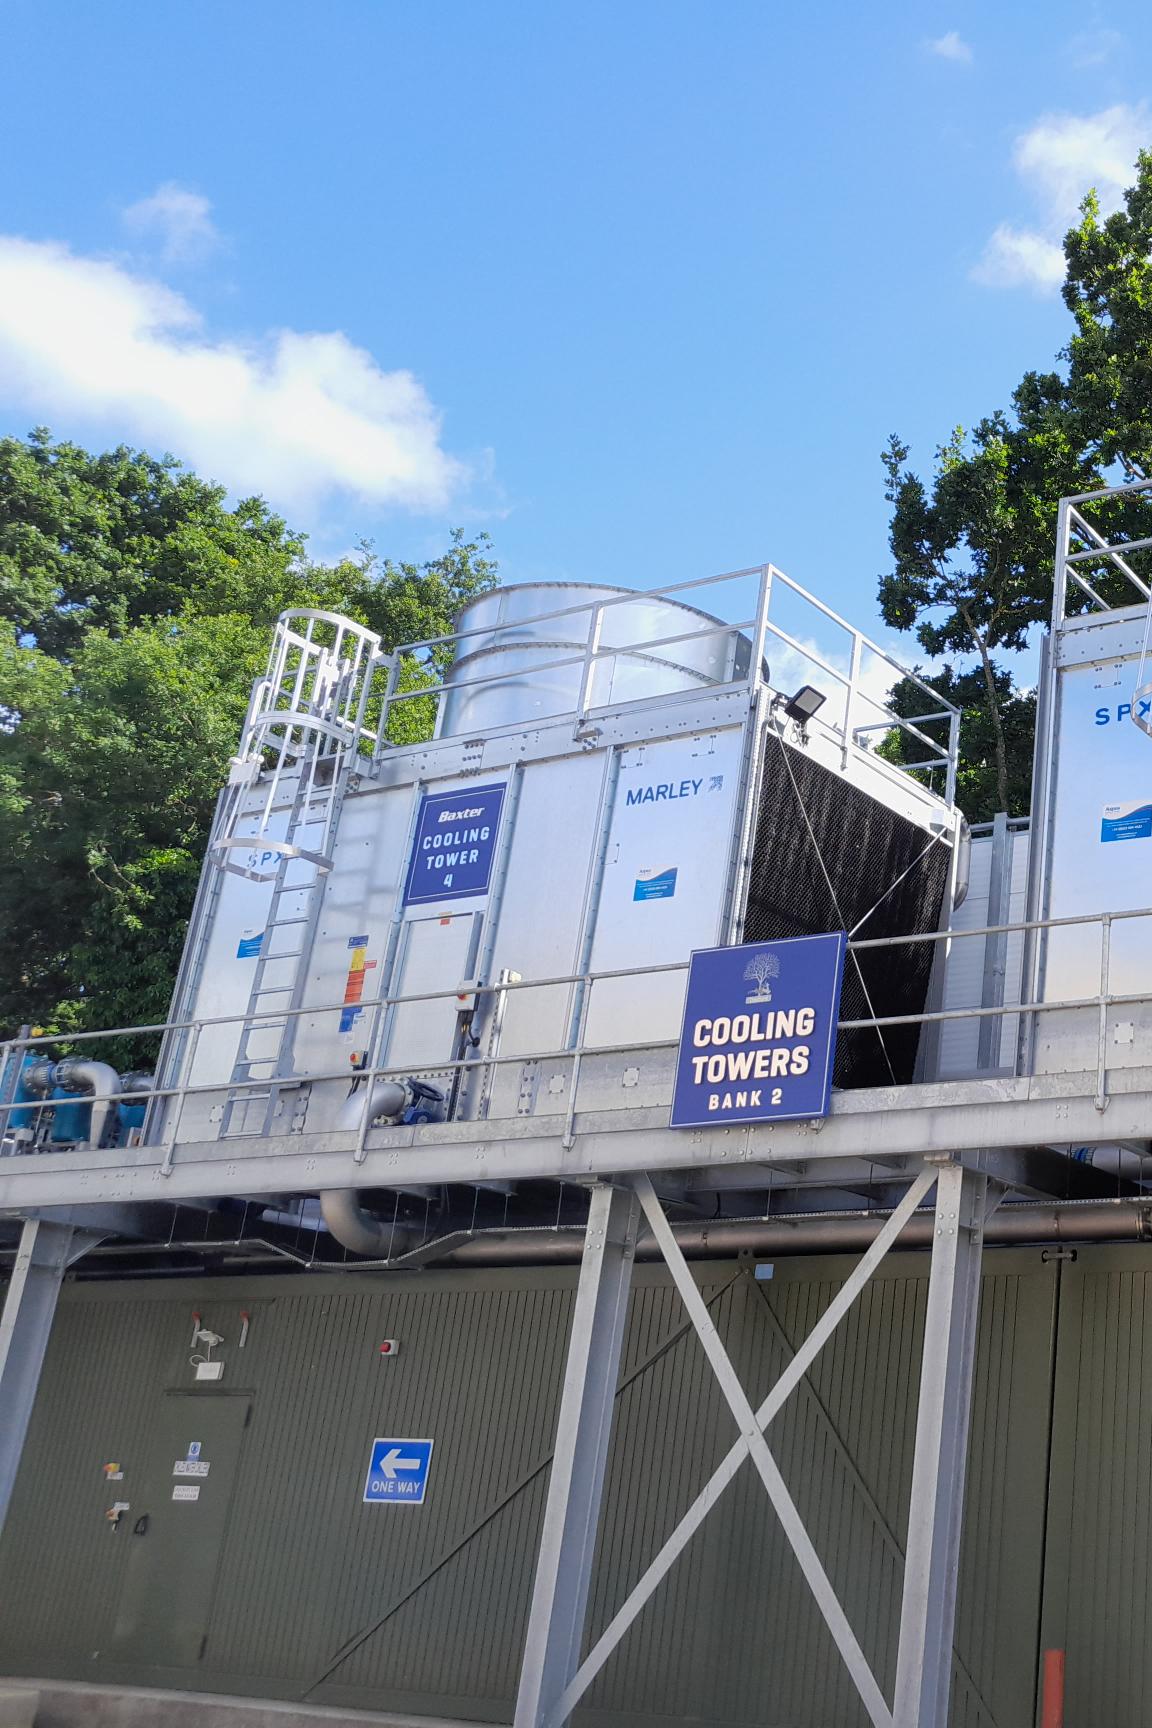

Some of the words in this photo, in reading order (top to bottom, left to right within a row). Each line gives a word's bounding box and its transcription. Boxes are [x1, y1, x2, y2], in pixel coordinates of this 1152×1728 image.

[626, 778, 703, 806] MARLEY
[437, 807, 485, 823] Baxter
[422, 826, 490, 850] COOLING
[426, 849, 479, 870] TOWER
[443, 873, 453, 888] 4
[693, 1007, 816, 1048] COOLING
[692, 1045, 810, 1085] TOWERS
[708, 1090, 762, 1111] BANK
[771, 1087, 783, 1105] 2
[371, 1480, 395, 1493] ONE
[397, 1481, 421, 1494] WAY
